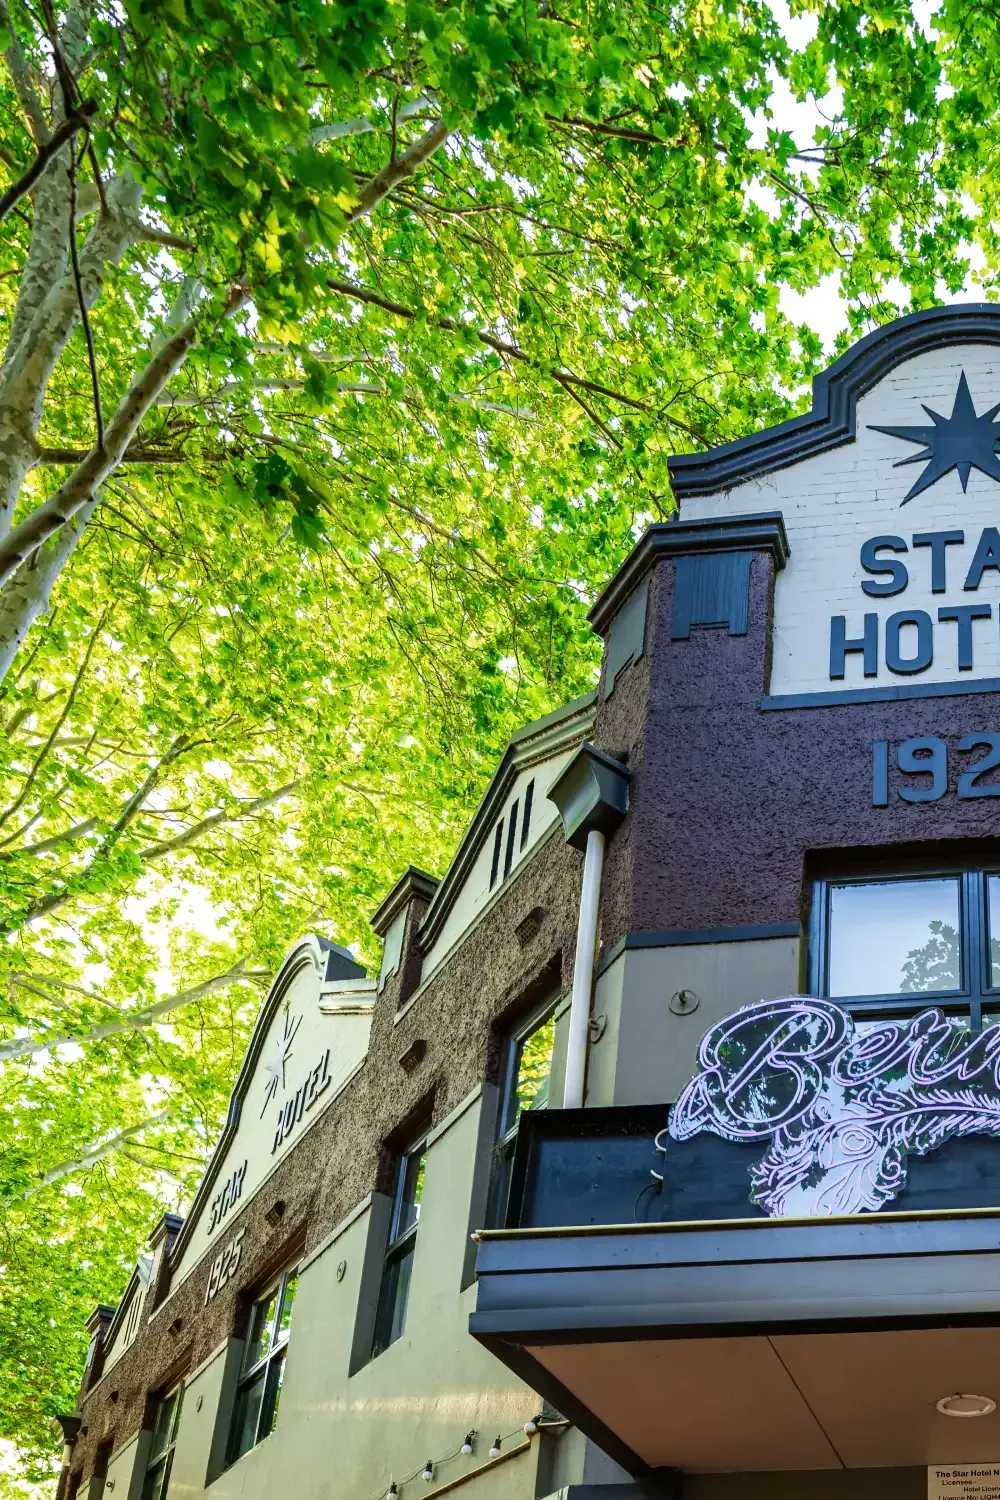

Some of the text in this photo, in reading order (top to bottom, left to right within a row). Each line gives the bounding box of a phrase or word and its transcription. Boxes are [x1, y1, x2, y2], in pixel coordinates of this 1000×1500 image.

[207, 1048, 332, 1236] STAR HOTEL
[204, 1222, 248, 1307] 1925
